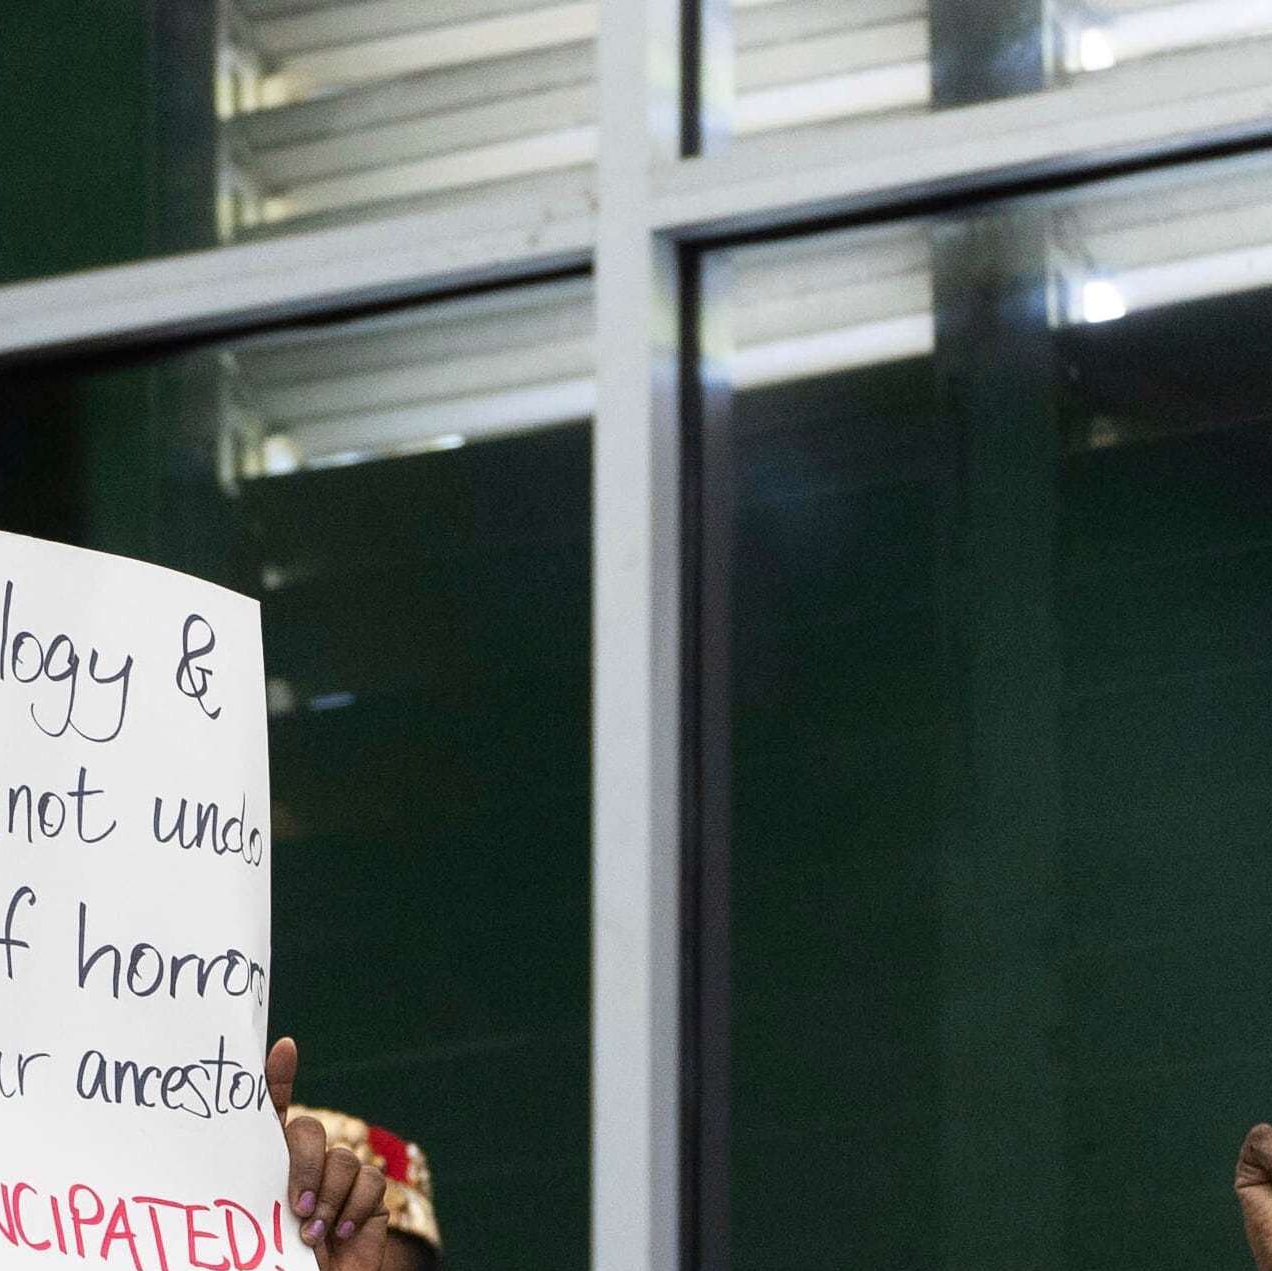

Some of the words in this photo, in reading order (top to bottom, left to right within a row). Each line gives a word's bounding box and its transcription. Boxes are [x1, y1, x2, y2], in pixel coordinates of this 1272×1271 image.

[176, 614, 221, 720] &
[152, 790, 263, 868] undo
[75, 1034, 277, 1122] ancestor
